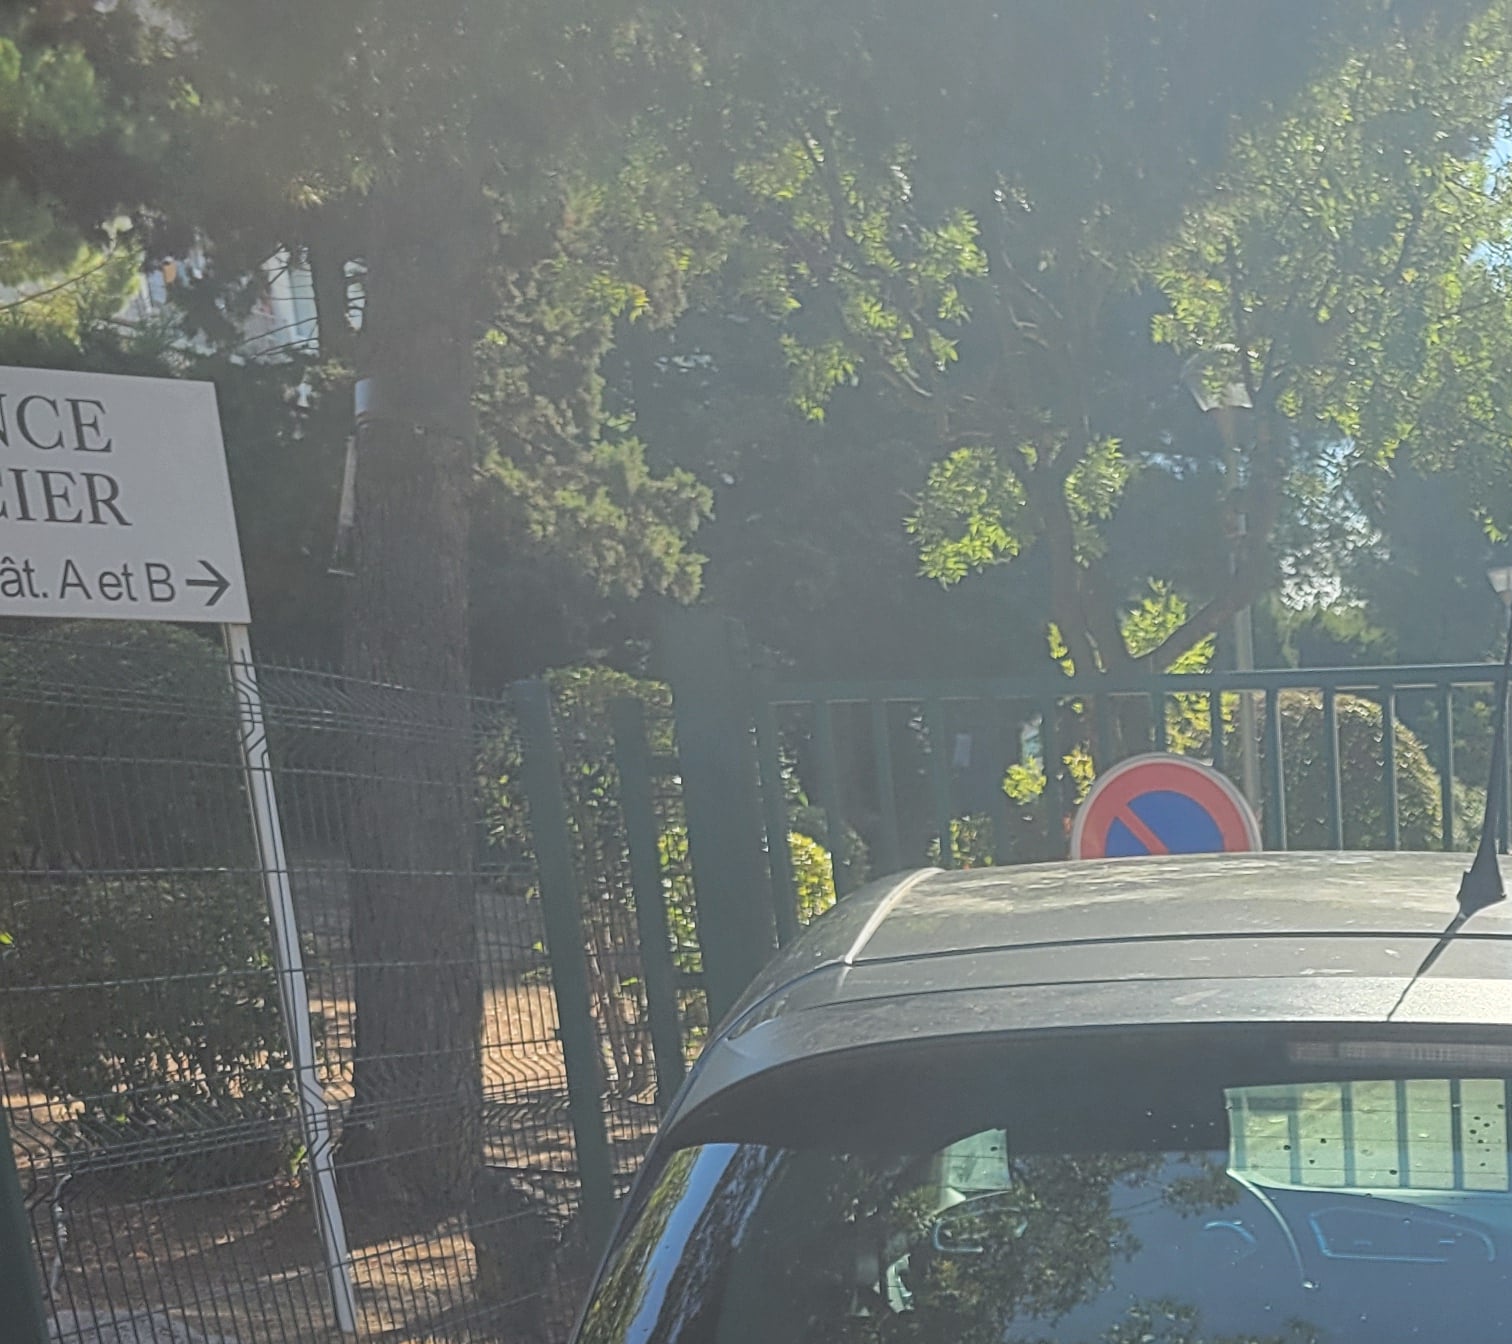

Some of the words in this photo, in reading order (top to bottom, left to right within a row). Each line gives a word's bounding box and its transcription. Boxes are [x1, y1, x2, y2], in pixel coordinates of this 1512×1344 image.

[0, 394, 112, 452] CE
[0, 468, 133, 526] IER
[59, 559, 92, 600] A
[99, 563, 138, 602] et
[145, 563, 176, 602] B
